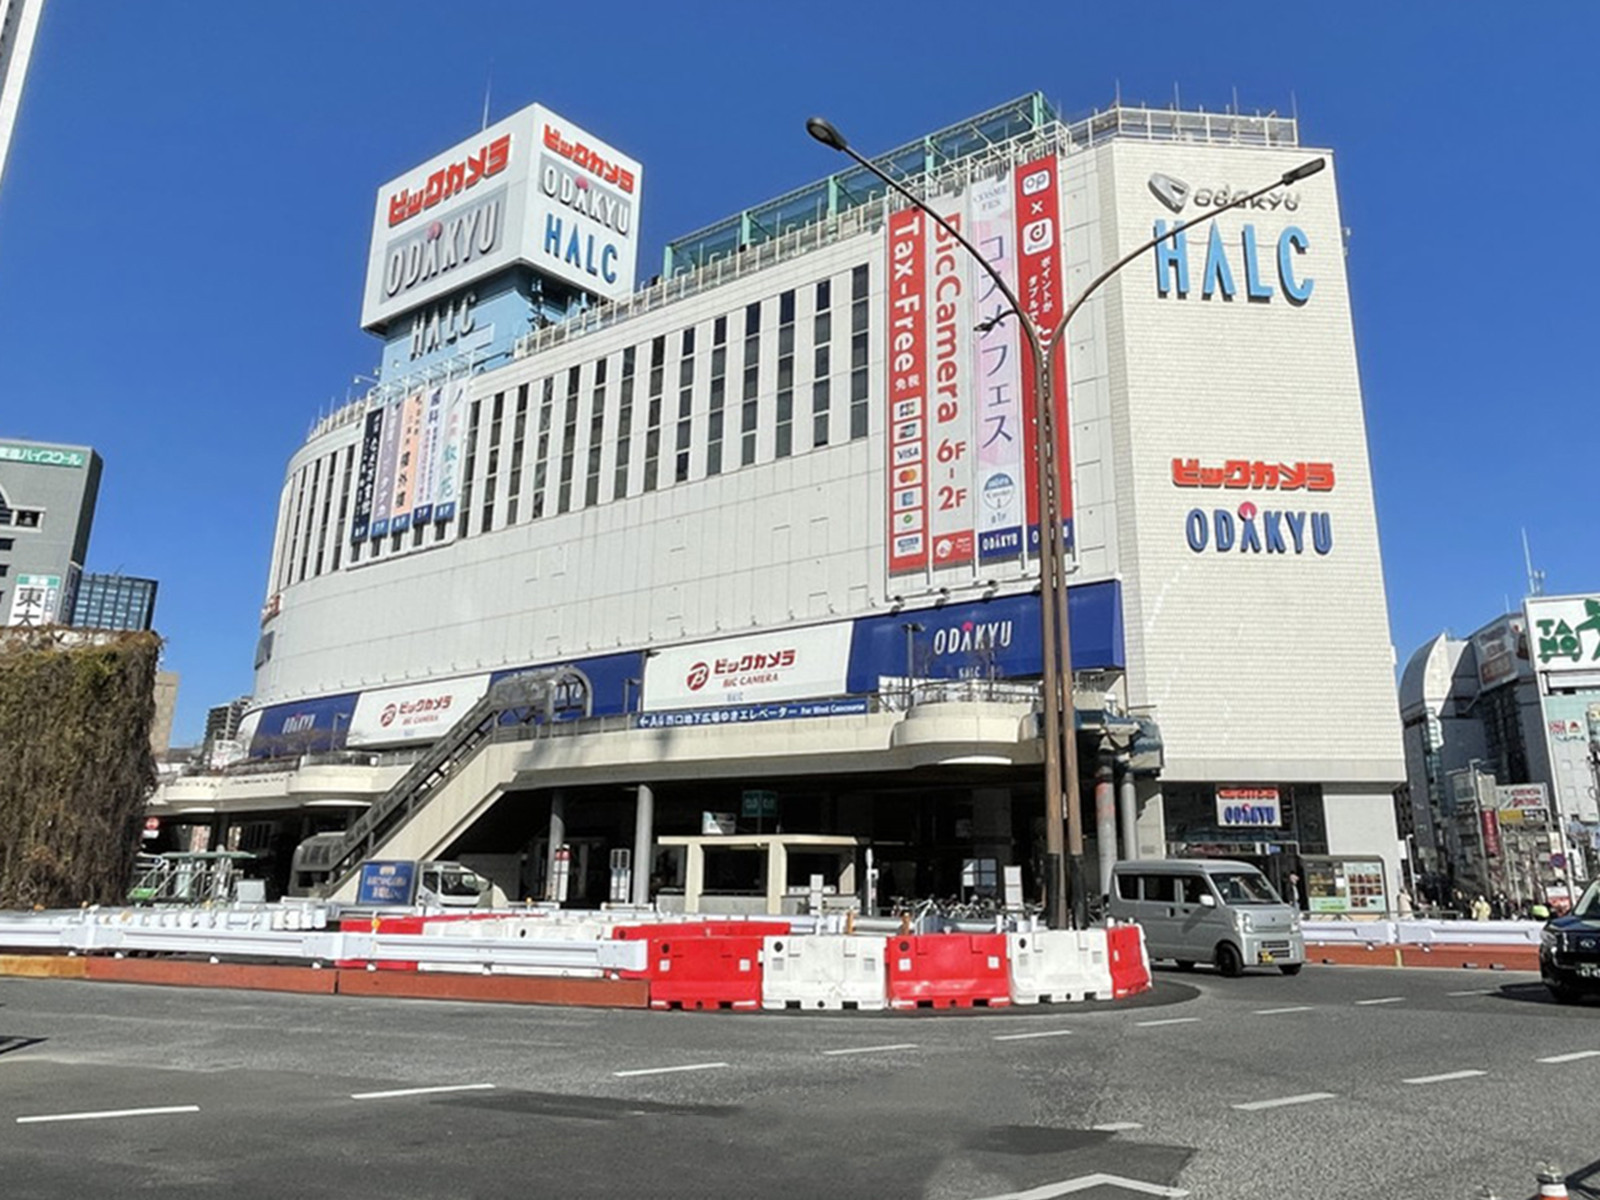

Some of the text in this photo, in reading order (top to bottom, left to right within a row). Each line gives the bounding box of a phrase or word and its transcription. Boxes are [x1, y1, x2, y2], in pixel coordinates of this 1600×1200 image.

[543, 123, 635, 195] ビックカメラ
[388, 132, 512, 227] ビックカメラ
[543, 167, 630, 237] ODAKYU
[385, 200, 501, 298] ODAKYU
[545, 213, 619, 285] HALC
[1153, 218, 1315, 307] HALC
[893, 215, 920, 372] Tax-Free
[410, 291, 477, 362] HALC
[897, 447, 920, 460] VISA
[936, 438, 966, 464] 6F
[1171, 458, 1335, 491] ビックカメラ
[938, 485, 967, 511] 2F
[982, 533, 1019, 551] ODAKYU
[1186, 501, 1333, 556] ODAKYU
[933, 620, 1013, 655] ODAKYU
[714, 649, 797, 675] ビックカメラ
[739, 673, 779, 686] CAMERA
[399, 695, 453, 715] ビックカメラ
[1224, 803, 1275, 824] ODAKYU
